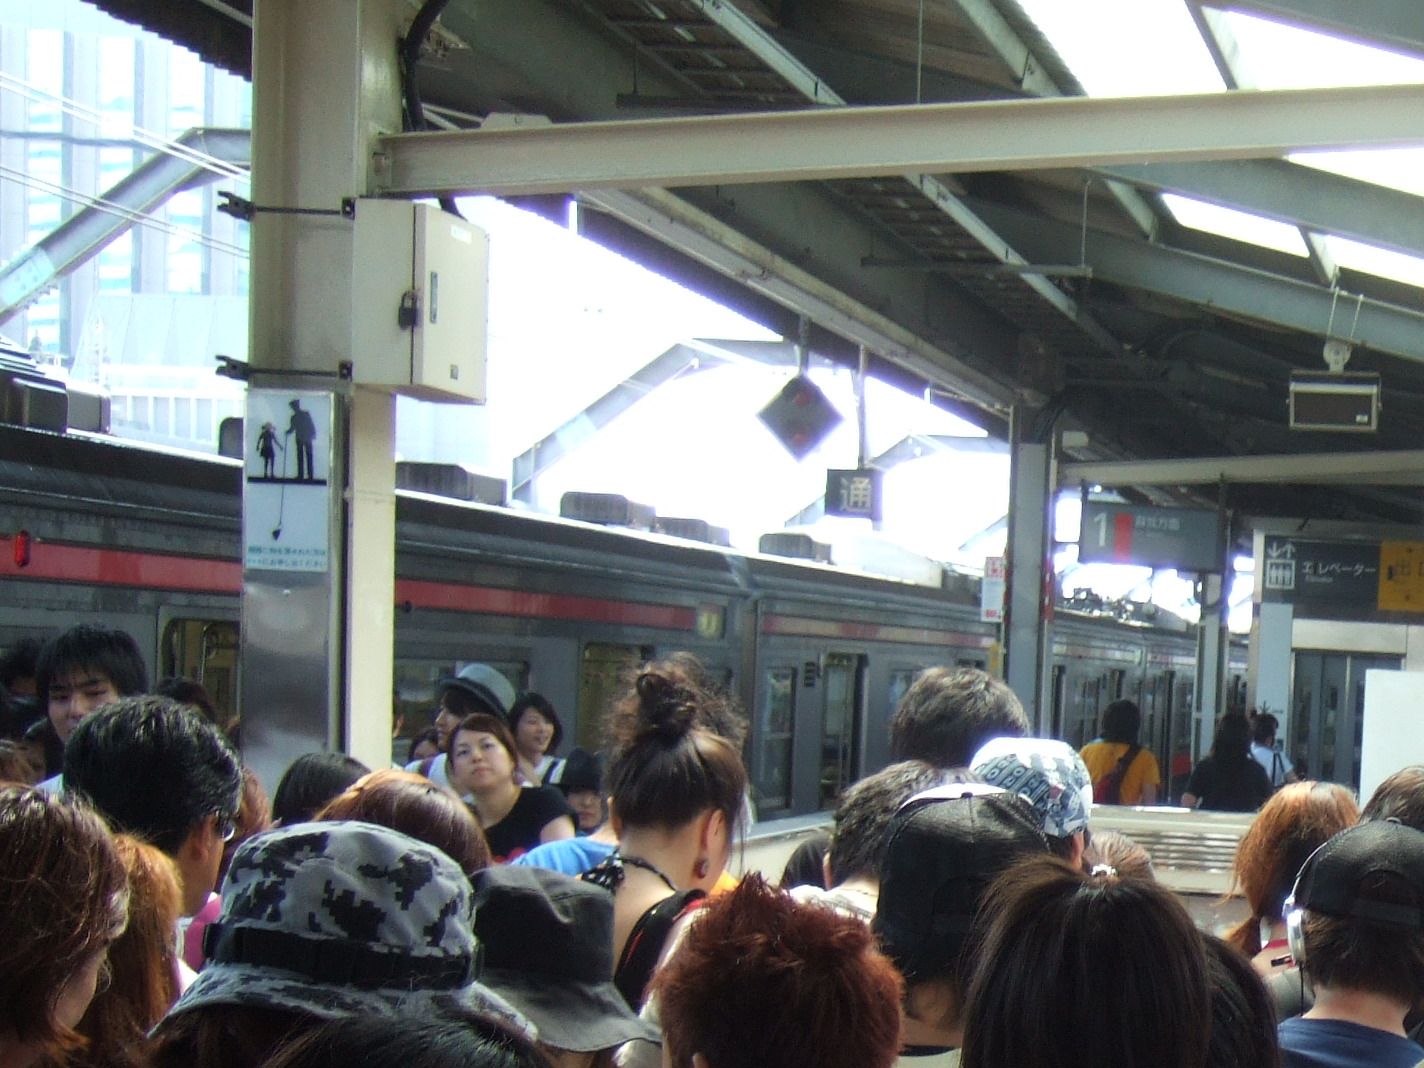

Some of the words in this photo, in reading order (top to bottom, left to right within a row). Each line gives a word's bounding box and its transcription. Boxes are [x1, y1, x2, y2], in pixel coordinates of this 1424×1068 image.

[1094, 512, 1107, 547] 1
[1302, 560, 1376, 577] エレベーター
